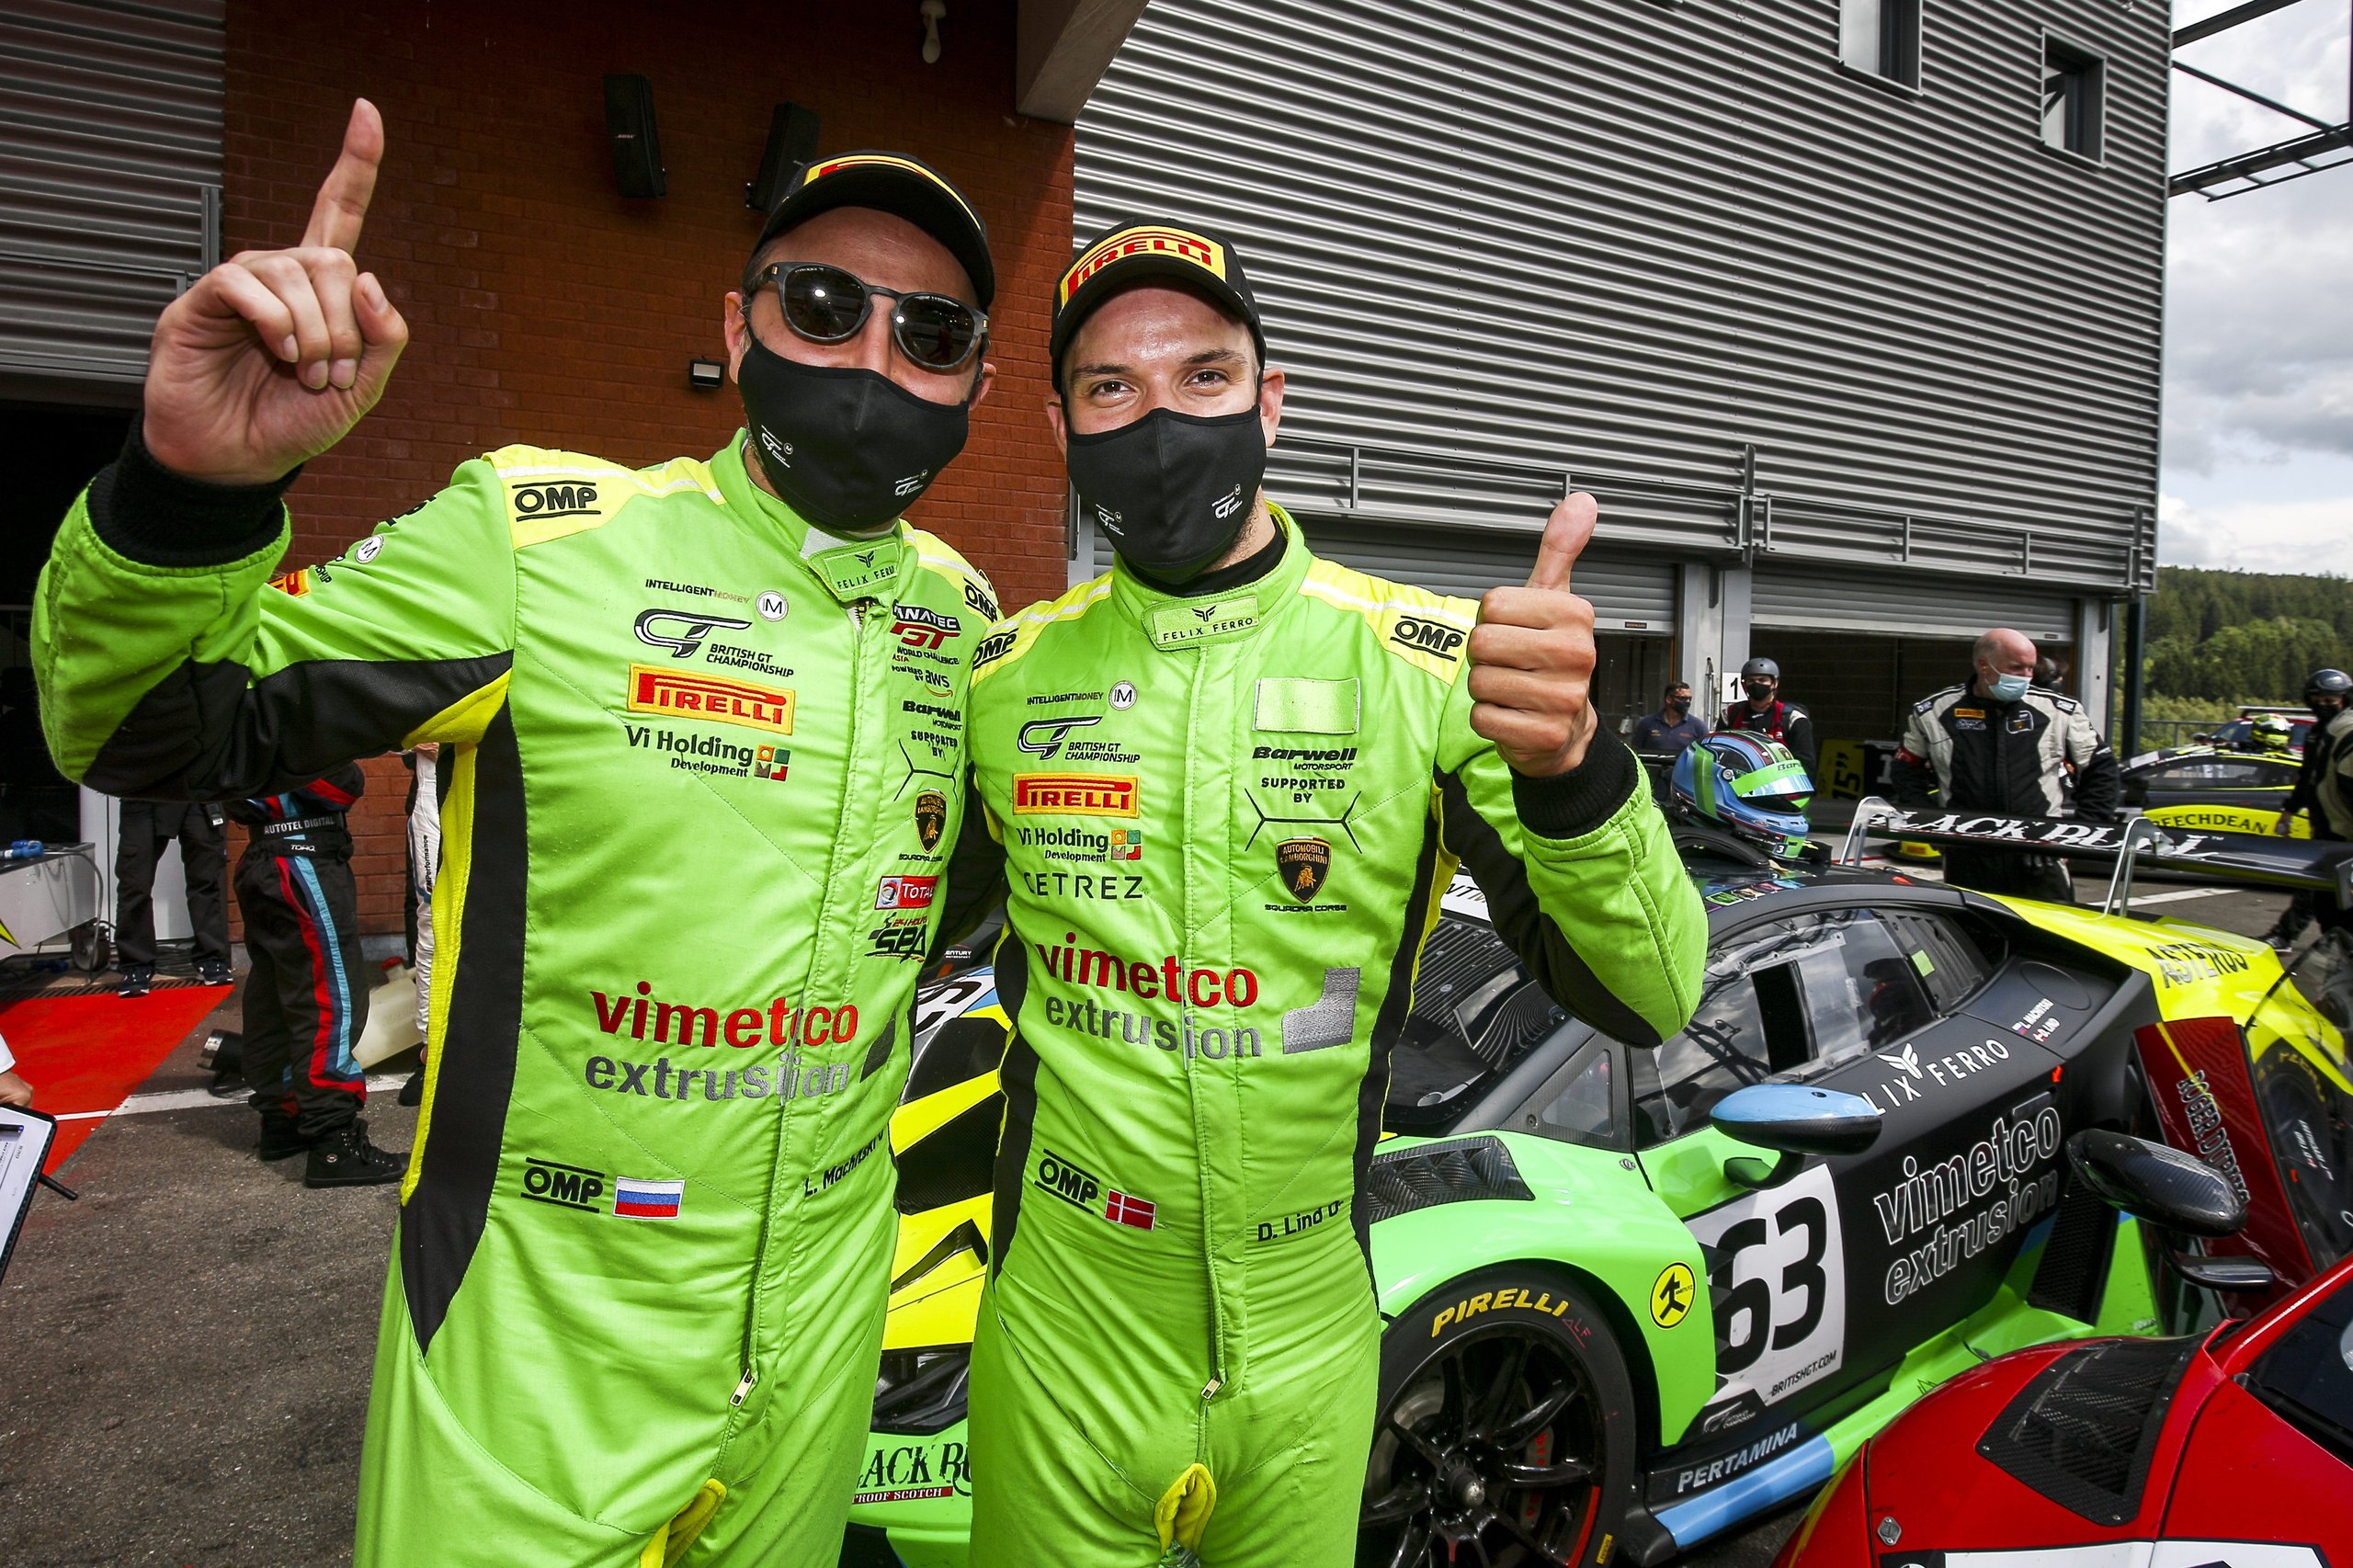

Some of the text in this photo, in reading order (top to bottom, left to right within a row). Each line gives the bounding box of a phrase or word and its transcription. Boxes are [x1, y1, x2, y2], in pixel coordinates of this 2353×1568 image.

[1067, 231, 1211, 299] PIRELLI
[514, 485, 598, 513] OMP
[837, 575, 869, 589] FELIX
[1163, 617, 1254, 642] FELIX FERRO
[1394, 620, 1463, 653] OMP
[706, 653, 794, 677] CHAMPIONSHIP
[710, 643, 773, 664] BRITISH GT
[892, 653, 909, 662] ASIA
[897, 646, 960, 665] WORLD CHALLENGE
[925, 670, 949, 688] aws
[637, 673, 787, 724] PIRELLI
[903, 700, 961, 722] Barwell
[1027, 692, 1104, 706] INTELLIGENTMONEY
[624, 726, 754, 767] Vi Holding
[911, 731, 958, 747] SUPPORTED
[1068, 743, 1120, 752] BRITISH GT
[932, 747, 943, 757] BY
[1064, 751, 1140, 763] CHAMPIONSHIP
[1252, 746, 1358, 761] Barwell
[670, 756, 748, 778] Development
[1017, 778, 1132, 810] PIRELLI
[1261, 778, 1346, 790] SUPPORTED
[1293, 792, 1313, 802] BY
[264, 815, 335, 835] AUTOTEL DIGITAL
[290, 844, 316, 852] TORQ
[1017, 827, 1108, 853] Vi Holding
[1044, 850, 1107, 863] Development
[903, 883, 934, 899] TOTAL
[1035, 931, 1258, 1008] vimetco
[591, 981, 858, 1048] vimetco
[1045, 994, 1263, 1060] extrusion
[585, 1052, 851, 1101] extrusion
[1862, 1039, 2010, 1116] LIX FERRO
[523, 1166, 603, 1206] OMP
[805, 1177, 818, 1197] L.
[1039, 1157, 1098, 1204] OMP
[1873, 1107, 2062, 1245] vimetco
[1257, 1221, 1279, 1242] D.
[1284, 1207, 1323, 1235] Lind
[1885, 1169, 2059, 1305] extrusion
[1711, 1197, 1828, 1376] 63
[1431, 1289, 1570, 1338] PIRELLI
[1770, 1350, 1837, 1397] BRITISHGT.COM
[856, 1446, 932, 1489] ACK
[1677, 1423, 1797, 1494] PERTAMINA
[893, 1487, 942, 1500] SCOTCH
